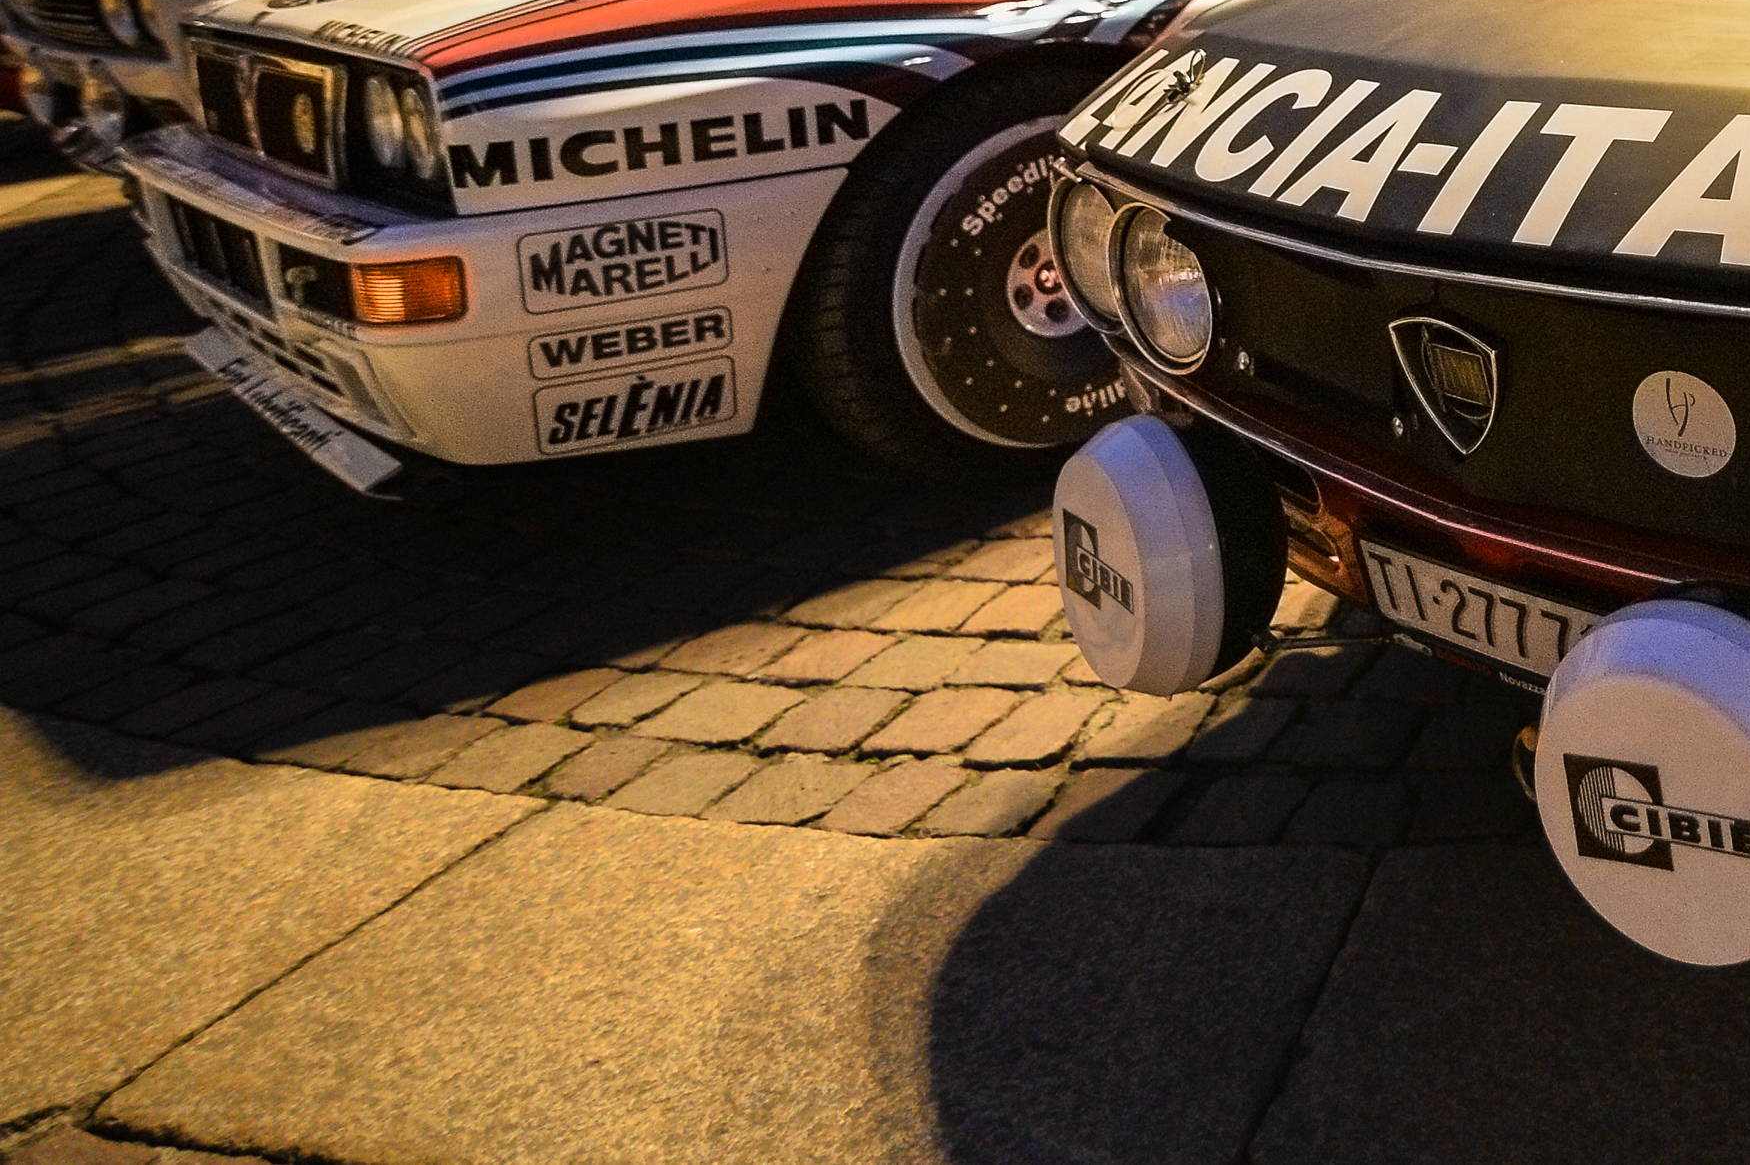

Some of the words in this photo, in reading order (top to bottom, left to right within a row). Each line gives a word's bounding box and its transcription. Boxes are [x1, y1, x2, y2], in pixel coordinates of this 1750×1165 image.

[448, 99, 871, 189] MICHELIN
[530, 219, 720, 295] MAGNETI
[530, 227, 720, 298] MARELLI
[540, 313, 726, 367] WEBER
[1646, 435, 1728, 458] HANDPICKED
